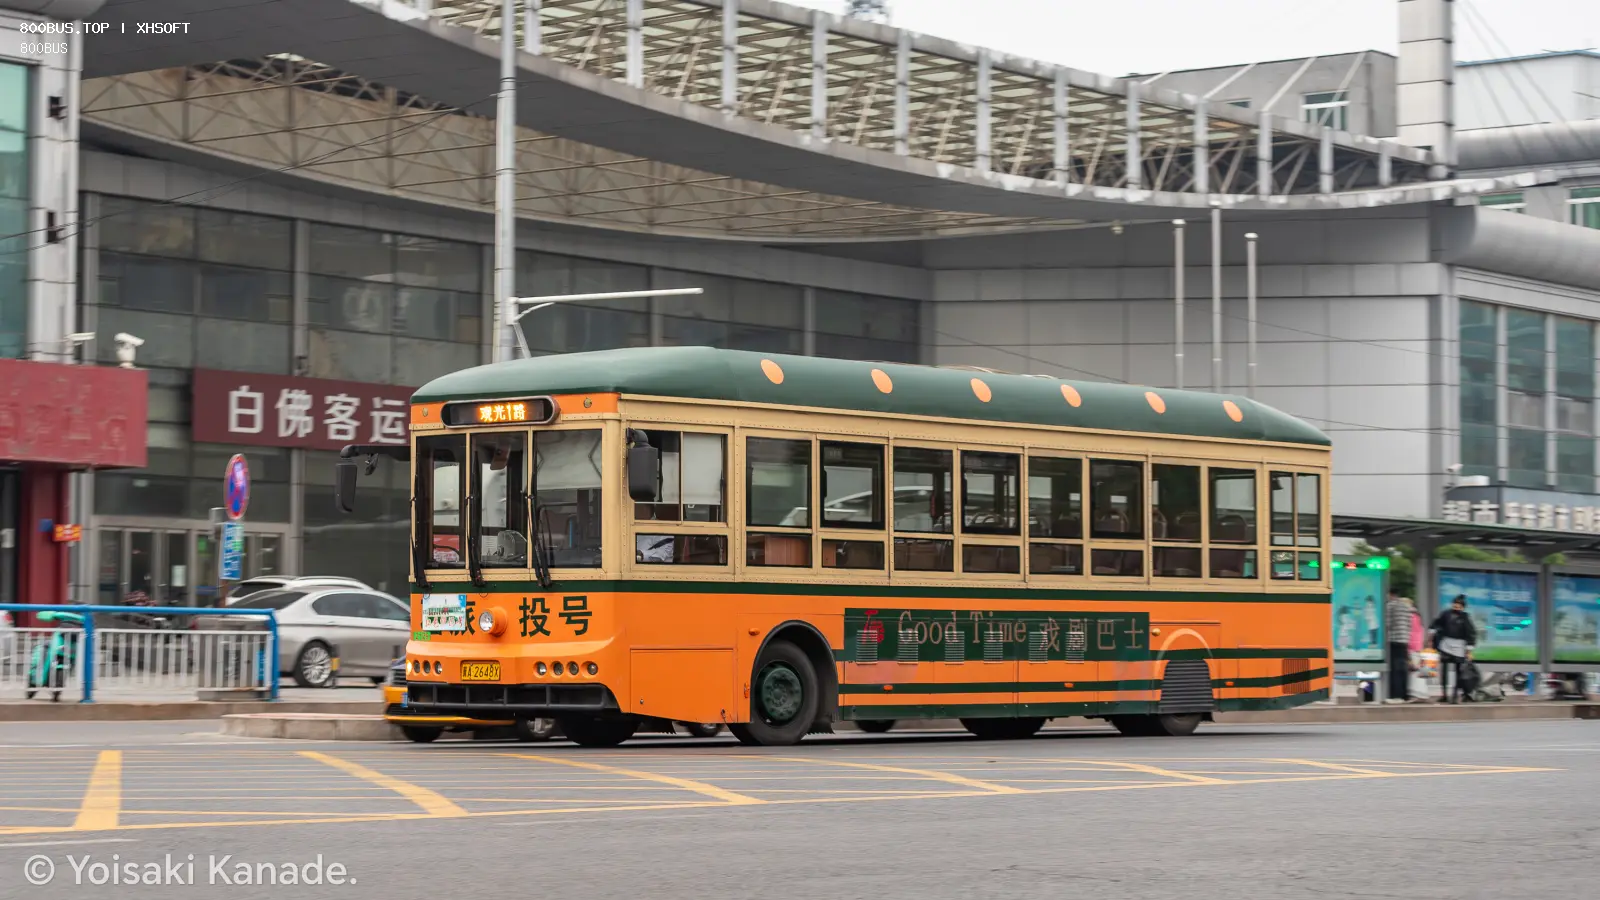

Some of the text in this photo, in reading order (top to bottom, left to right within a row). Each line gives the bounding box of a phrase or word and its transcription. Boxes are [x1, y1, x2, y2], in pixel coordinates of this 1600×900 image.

[228, 385, 407, 444] 白佛客运
[480, 403, 525, 422] 观光1路
[898, 610, 960, 644] Good
[969, 611, 1027, 643] Time
